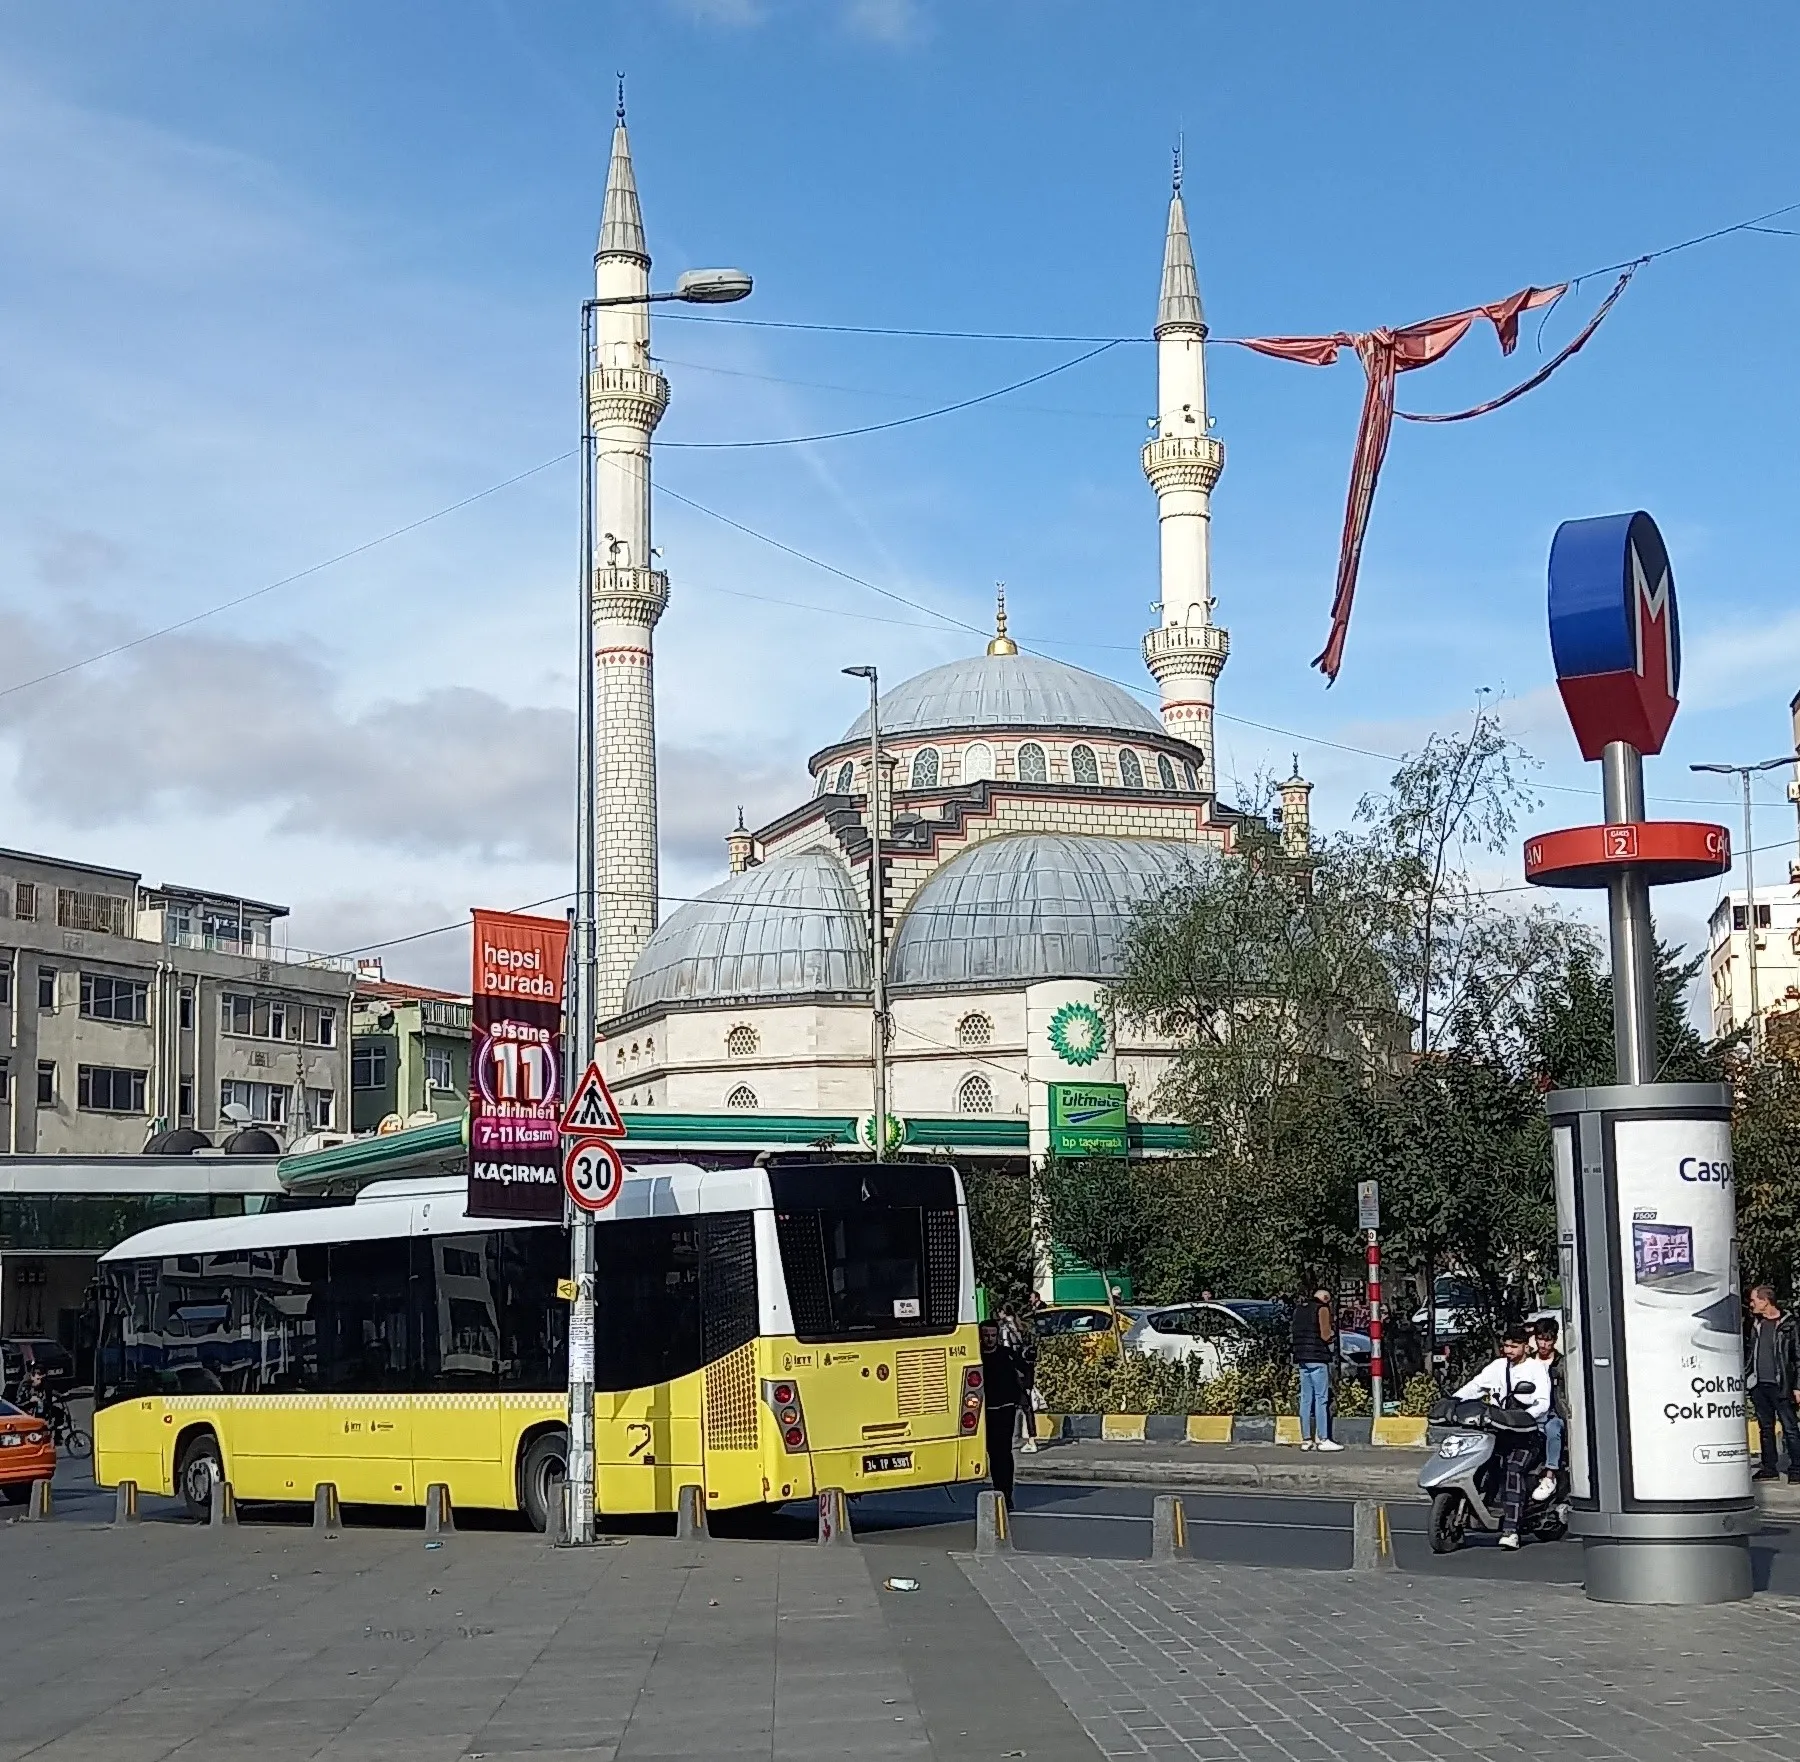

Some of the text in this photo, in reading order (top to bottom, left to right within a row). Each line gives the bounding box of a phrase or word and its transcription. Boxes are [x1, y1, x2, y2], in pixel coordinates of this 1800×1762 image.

[1631, 537, 1675, 699] M
[1614, 837, 1628, 855] 2
[483, 942, 541, 972] hepsi
[483, 969, 555, 997] burada
[490, 1019, 550, 1043] efsane
[491, 1041, 544, 1101] 11
[1062, 1093, 1121, 1107] ultimate
[480, 1126, 553, 1144] 7-11 Kasım
[1062, 1136, 1077, 1149] bp
[473, 1162, 558, 1186] KAÇIRMA
[576, 1156, 611, 1191] 30
[1691, 1375, 1725, 1398] Çok
[1664, 1402, 1704, 1424] Çok
